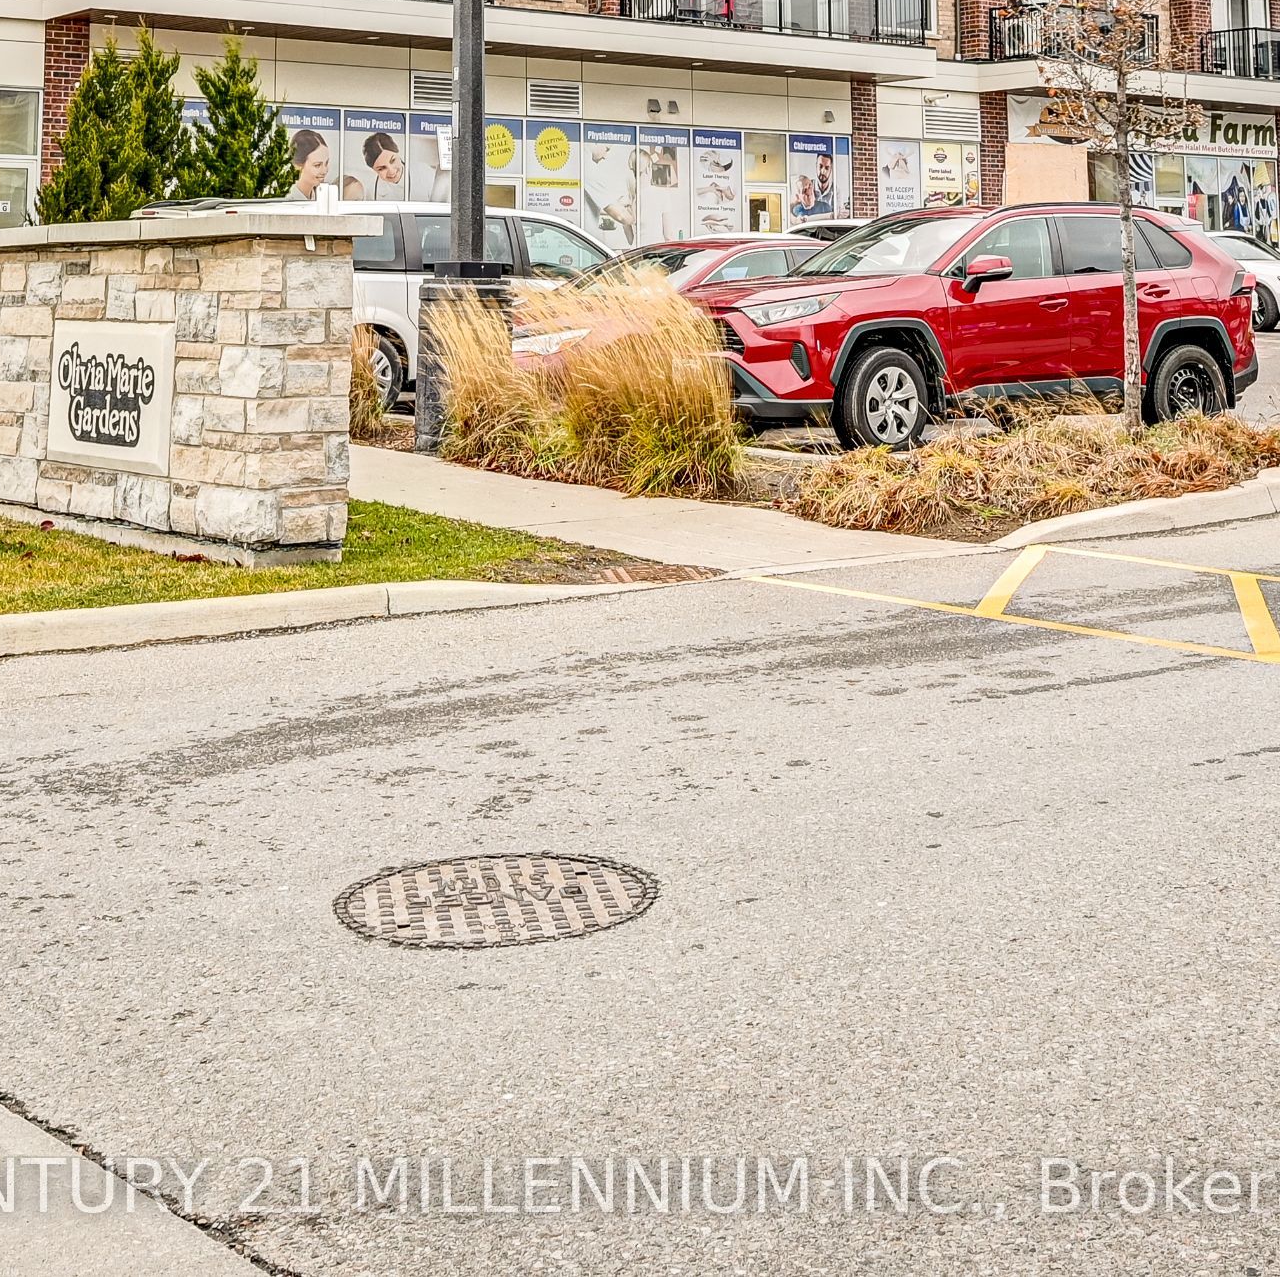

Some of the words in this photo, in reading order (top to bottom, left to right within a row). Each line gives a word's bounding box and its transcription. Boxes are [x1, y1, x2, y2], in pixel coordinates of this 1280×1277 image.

[312, 116, 334, 127] Clinic
[347, 118, 371, 130] Family
[371, 120, 401, 130] Practice
[1209, 113, 1276, 146] Farm
[538, 136, 564, 146] ACCEPTING
[587, 131, 631, 143] Physiotherapy
[639, 133, 664, 143] Massage
[665, 134, 687, 145] Therapy
[695, 135, 711, 145] Other
[711, 136, 736, 147] Services
[486, 140, 507, 149] EMALE
[793, 142, 827, 152] Chiropractic
[1185, 144, 1201, 152] Halal
[1218, 145, 1244, 156] Butchery
[1251, 148, 1274, 157] Grocery
[486, 148, 512, 156] OCTORS
[540, 150, 567, 161] PATIENTS
[762, 154, 767, 164] 8
[59, 345, 105, 397] Olivia
[106, 356, 154, 399] Marie
[70, 394, 138, 443] Gardens
[405, 883, 587, 909] DANGER
